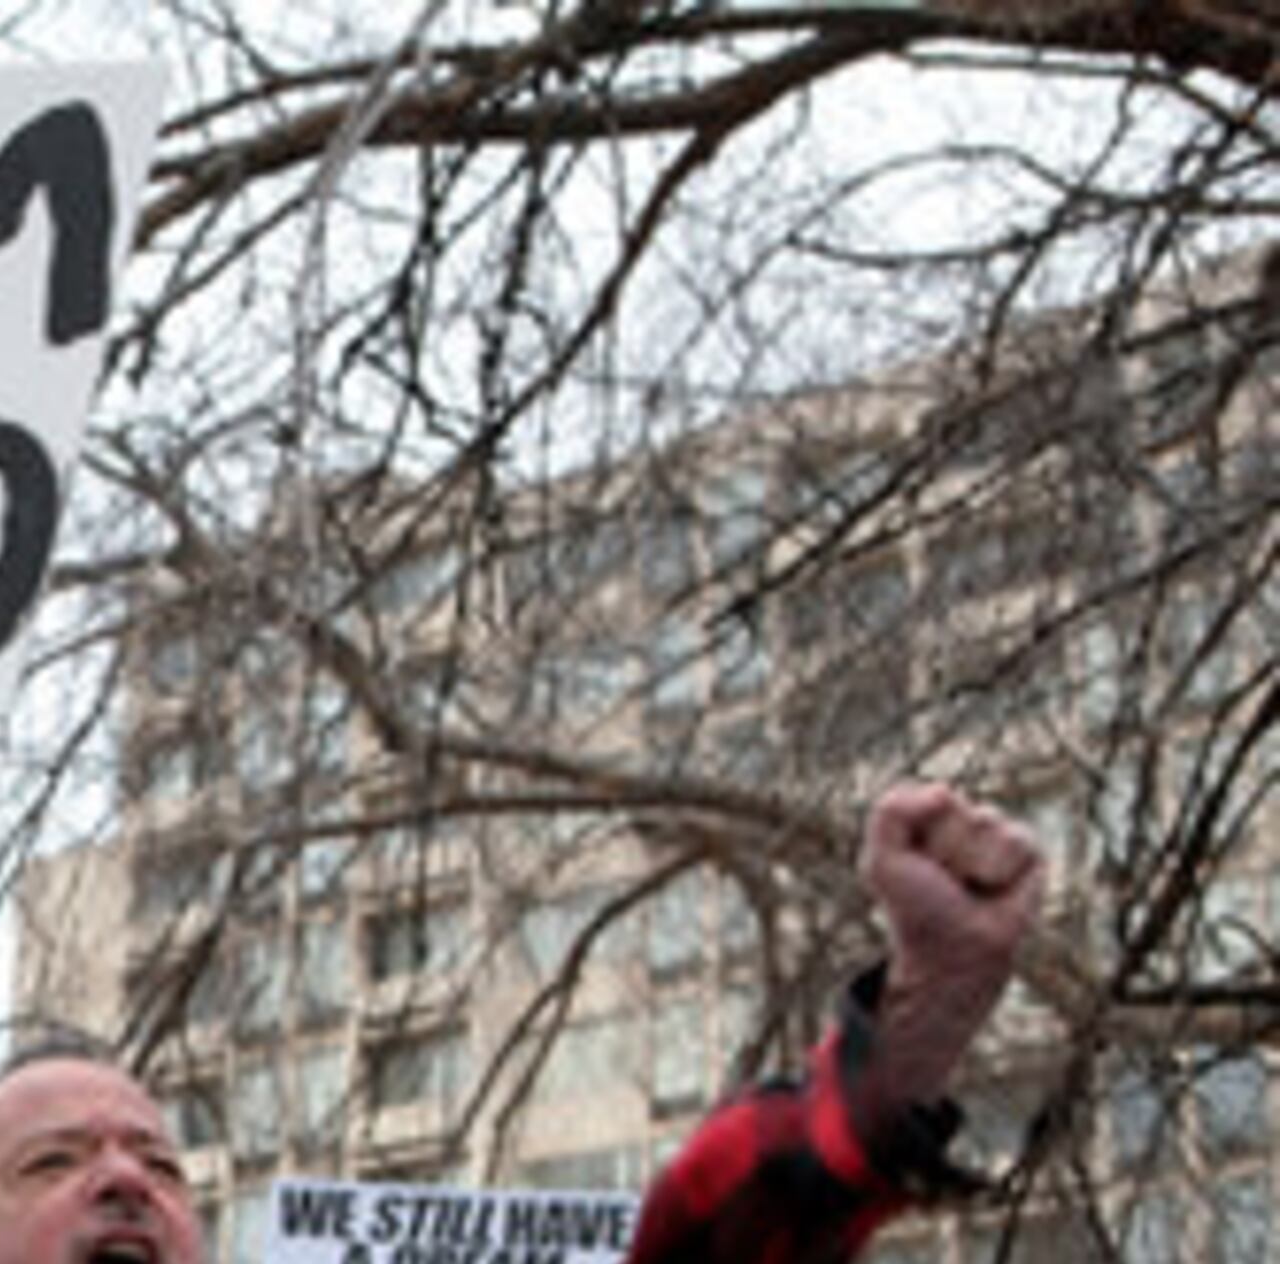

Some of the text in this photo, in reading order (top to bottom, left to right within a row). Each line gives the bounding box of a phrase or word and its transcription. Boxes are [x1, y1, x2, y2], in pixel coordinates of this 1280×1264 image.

[278, 1188, 634, 1250] WE STILL HAVE
